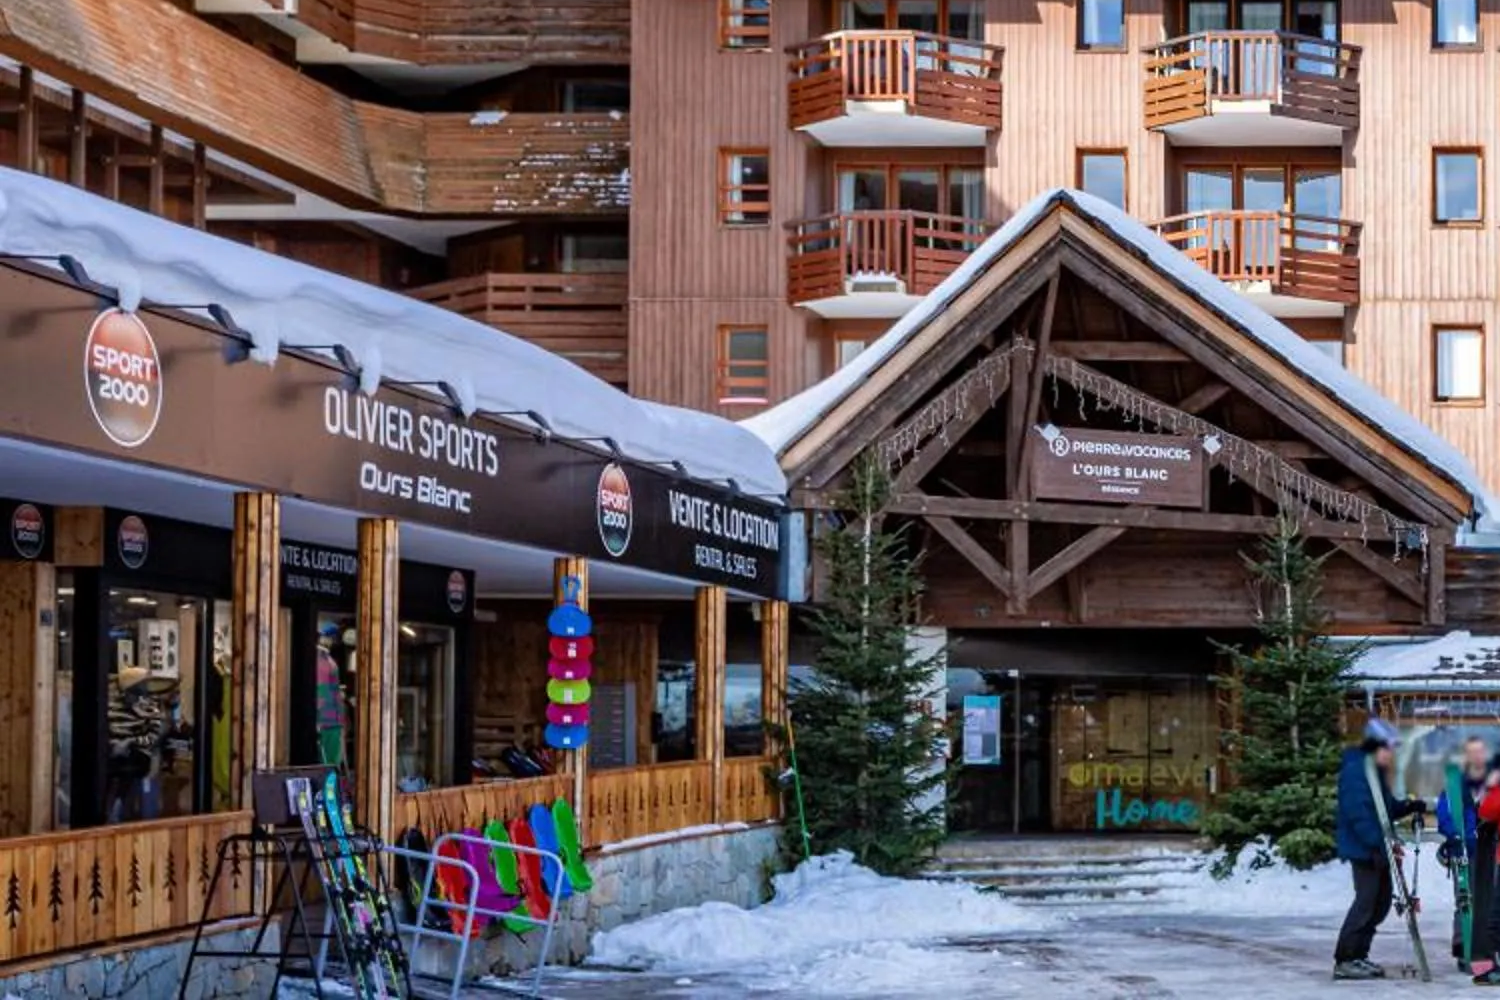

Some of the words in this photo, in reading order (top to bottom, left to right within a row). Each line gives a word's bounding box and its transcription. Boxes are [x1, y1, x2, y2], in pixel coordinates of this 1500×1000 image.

[92, 344, 154, 382] SPORT
[99, 374, 149, 407] 2000
[324, 386, 414, 454] OLIVIER
[418, 415, 499, 477] SPORTS
[360, 461, 413, 499] Ours
[416, 476, 472, 513] Blanc
[1072, 463, 1121, 477] L'OURS
[1124, 467, 1169, 481] BLANC
[600, 490, 628, 512] SPORT
[603, 511, 627, 529] 2000
[669, 489, 711, 533] VENTE
[713, 503, 722, 537] &
[723, 505, 779, 551] LOCATION
[695, 544, 724, 571] RENTAL
[733, 554, 757, 579] SALES
[1096, 787, 1199, 829] Home
